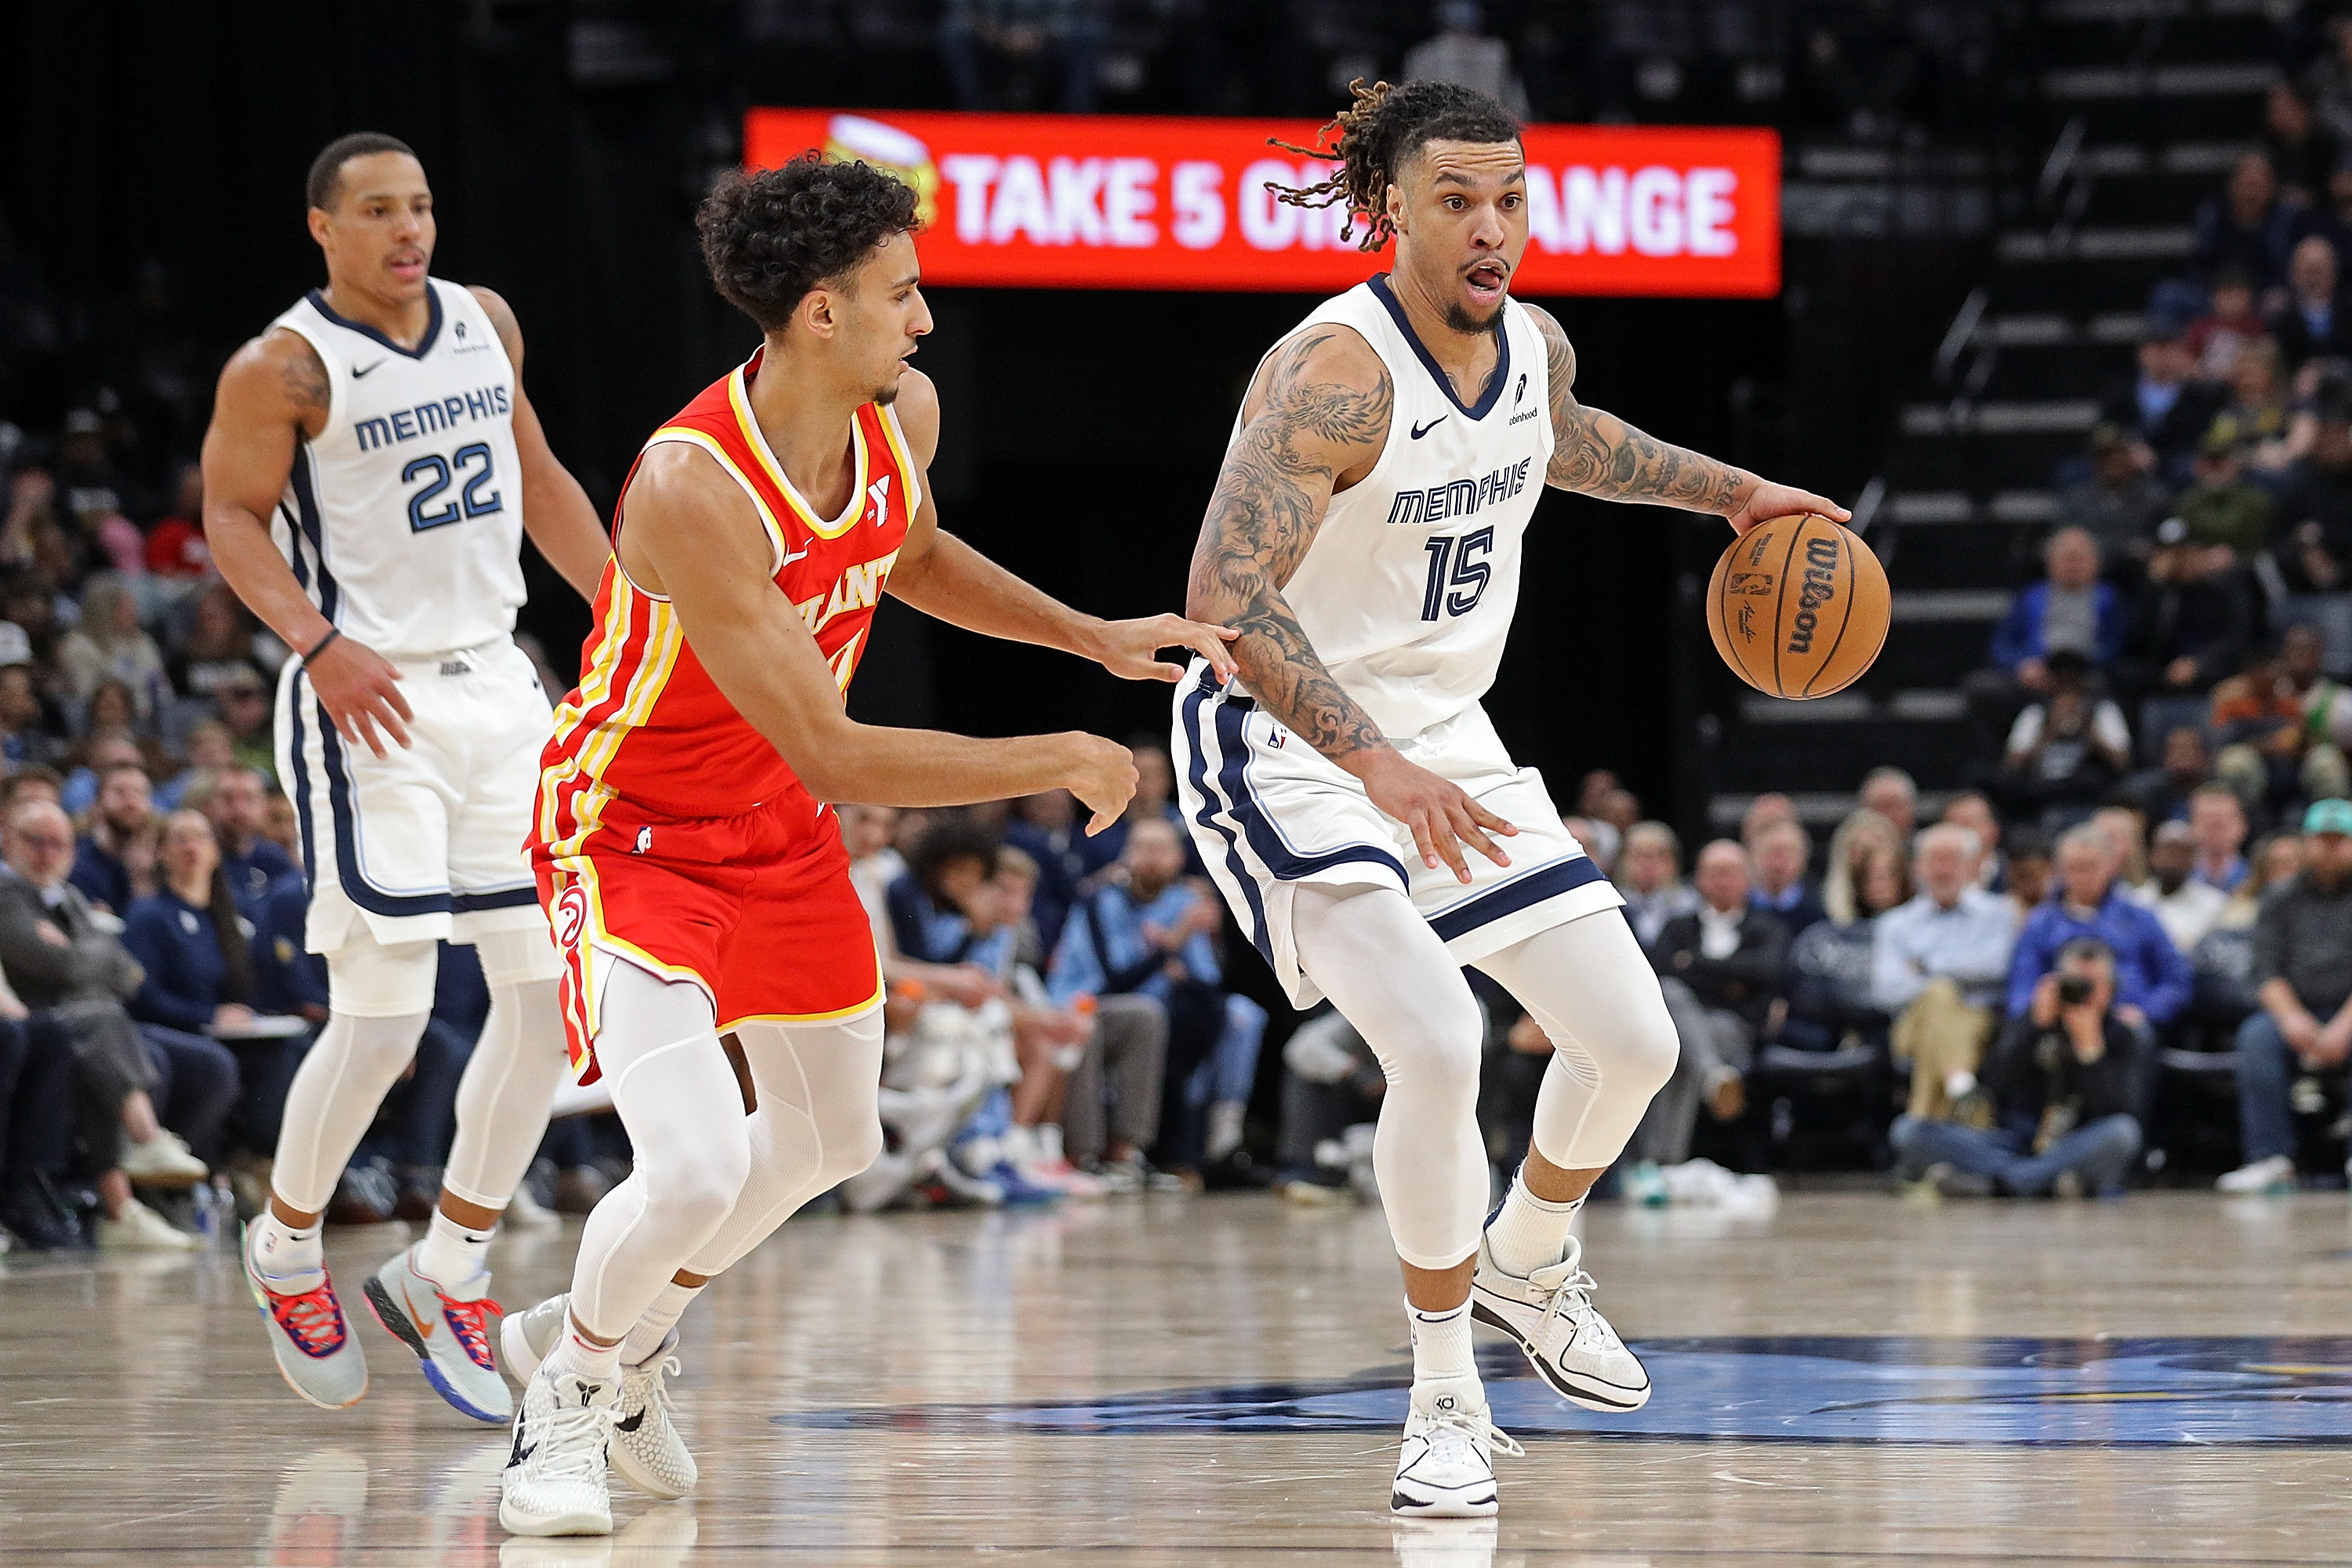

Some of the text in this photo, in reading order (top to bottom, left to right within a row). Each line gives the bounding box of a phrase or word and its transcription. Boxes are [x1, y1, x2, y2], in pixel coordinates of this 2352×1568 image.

[940, 153, 1160, 247] TAKE
[1171, 160, 1227, 250] 5
[1526, 164, 1739, 257] ANGE
[355, 384, 510, 452] MEMPHIS
[402, 441, 503, 534] 22
[1387, 456, 1531, 524] MEMPHIS
[1421, 524, 1494, 622] 15
[1787, 538, 1838, 654] Wilson
